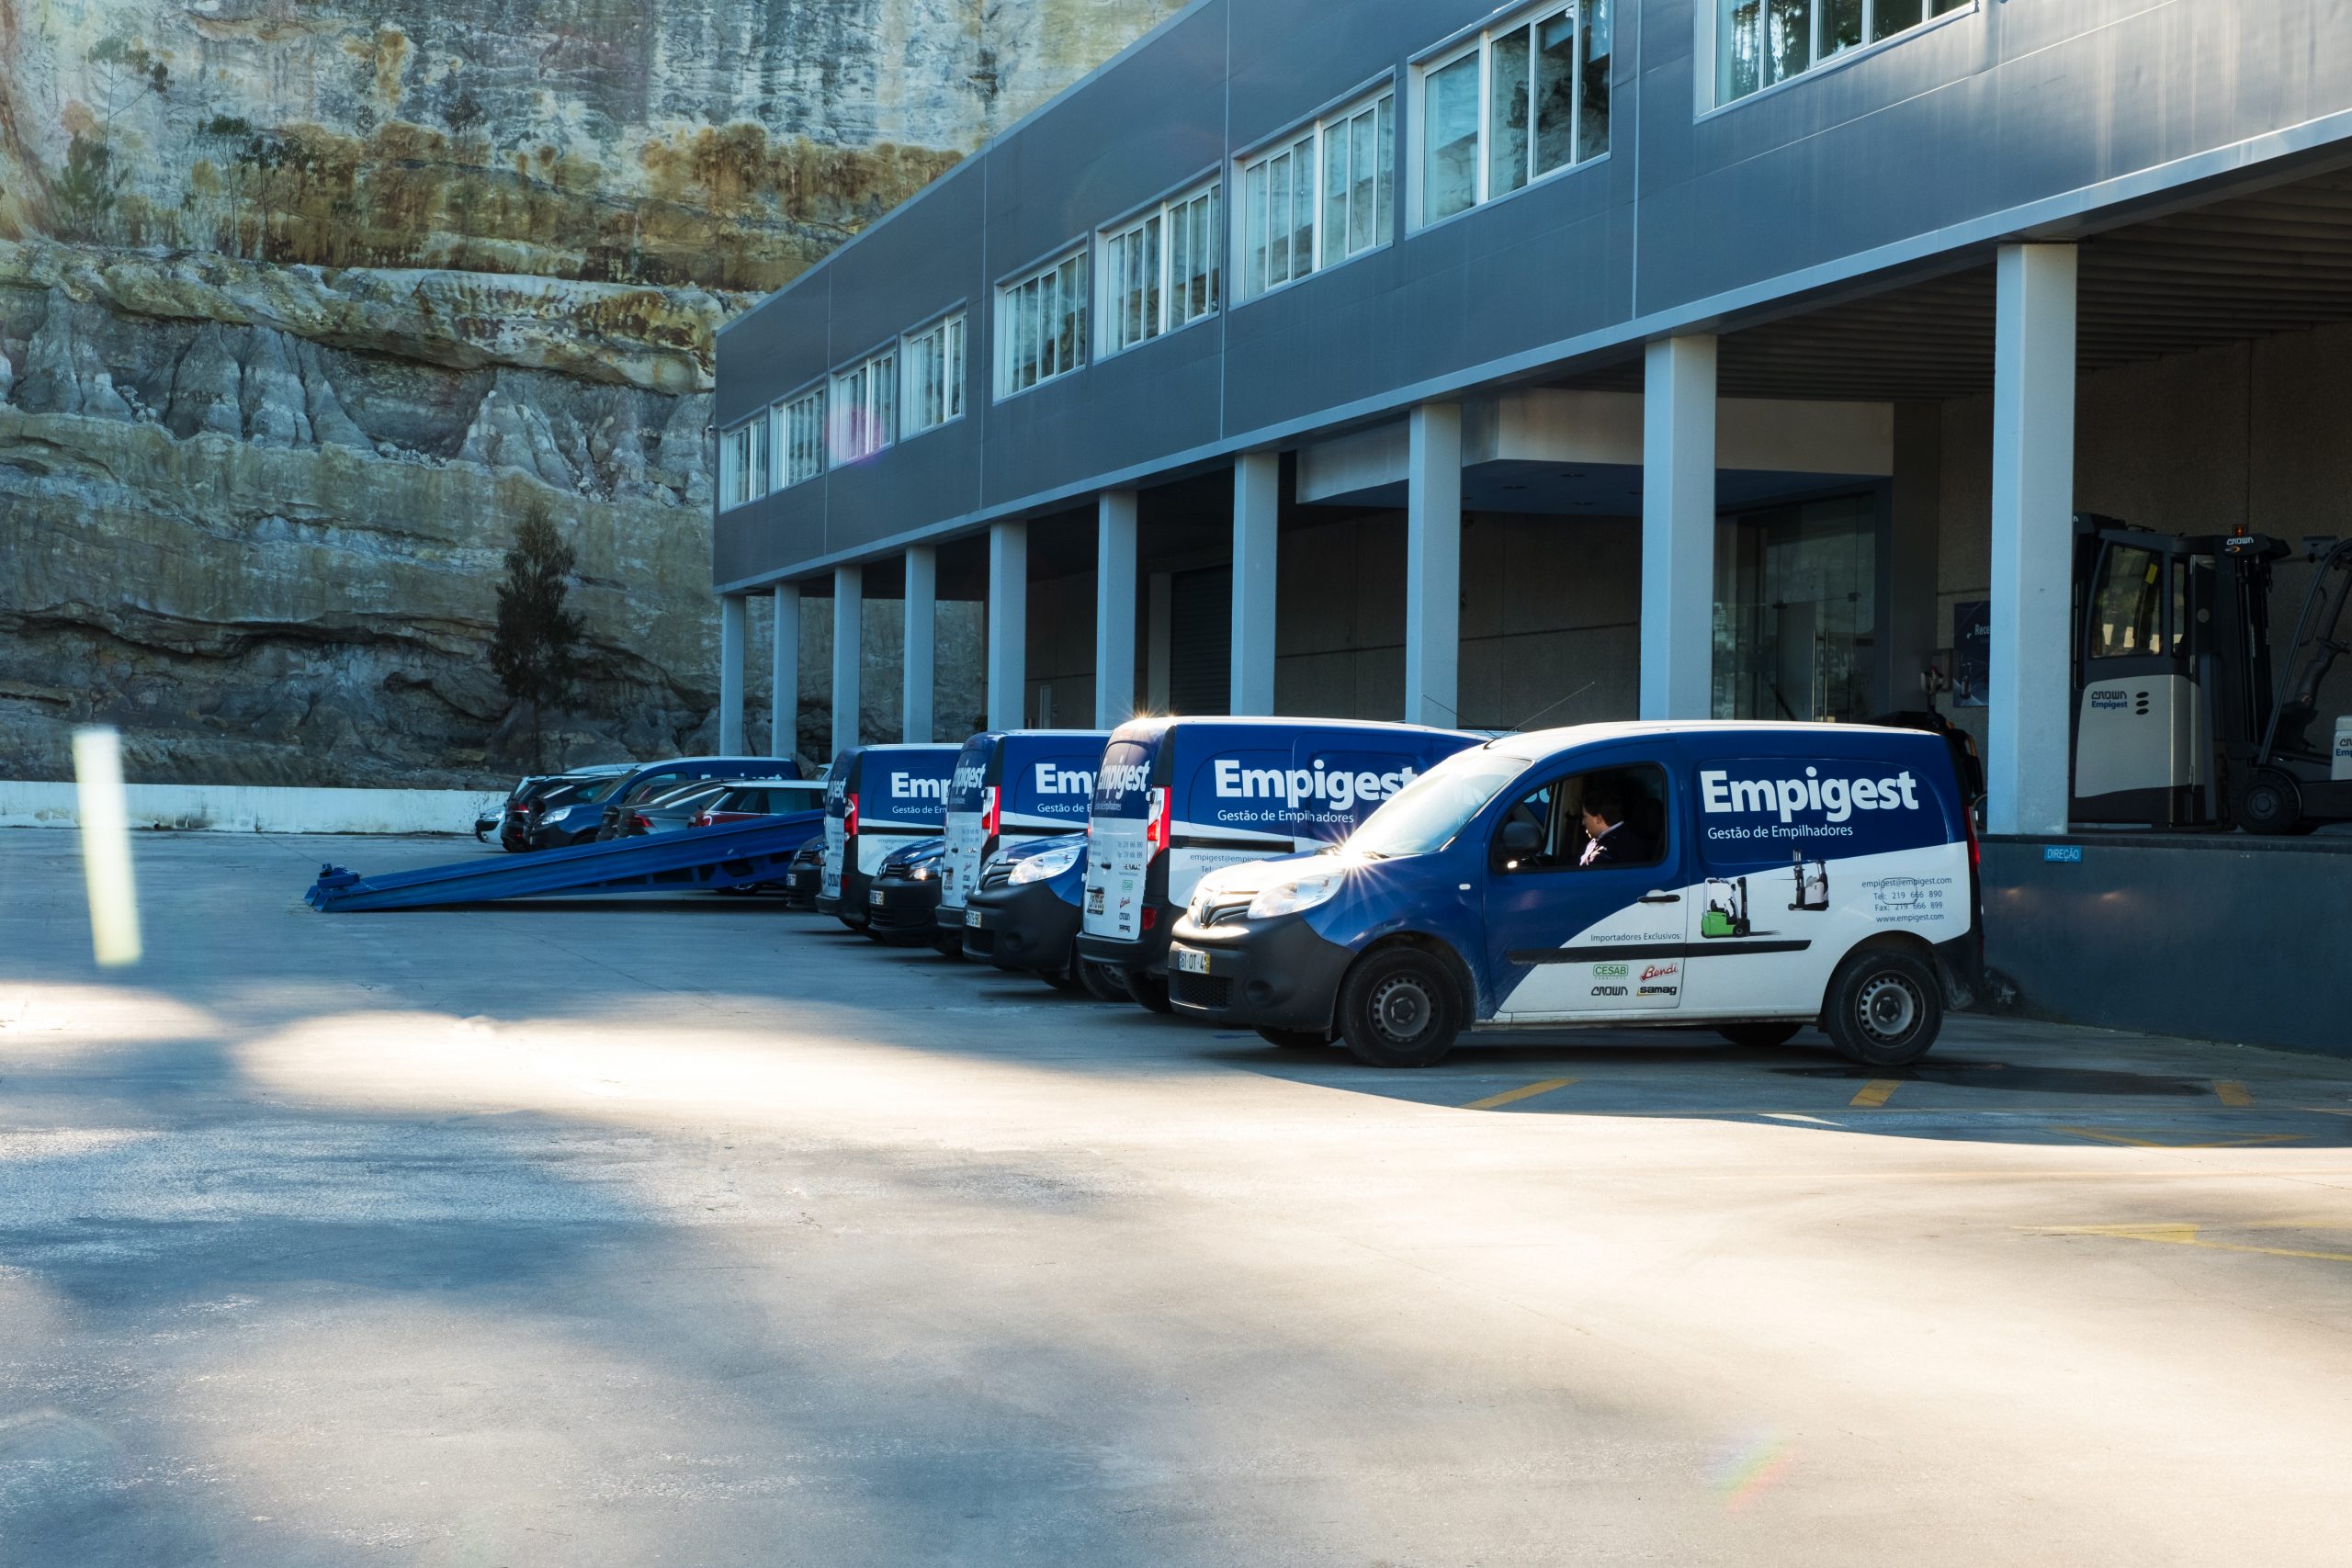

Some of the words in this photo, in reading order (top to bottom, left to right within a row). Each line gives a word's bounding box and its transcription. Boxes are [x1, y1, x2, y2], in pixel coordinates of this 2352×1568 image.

[2091, 700, 2128, 709] Empigest
[1700, 766, 1919, 823] Empigest
[892, 806, 921, 814] Gestão
[922, 806, 933, 814] de
[1037, 803, 1070, 813] Gestão
[1072, 803, 1085, 813] de
[1217, 809, 1258, 822] Gestão
[1261, 809, 1275, 821] de
[1707, 825, 1750, 840] Gestão
[1753, 825, 1770, 839] de
[1771, 824, 1853, 840] Empilhadores
[2047, 847, 2080, 862] DIREÇÃO
[1861, 877, 1952, 889] empigest@empigest.com
[1874, 892, 1887, 900] Tel:
[1892, 892, 1906, 900] 219
[1928, 890, 1942, 898] 890
[1895, 903, 1908, 911] 219
[1875, 914, 1945, 923] www.empigest.com
[1590, 933, 1642, 942] Importadores
[1643, 932, 1682, 941] Exclusivos:
[1595, 966, 1627, 975] CESAB
[1639, 964, 1678, 983] Bendi
[1590, 986, 1629, 996] CROWN
[1639, 986, 1678, 995] samag
